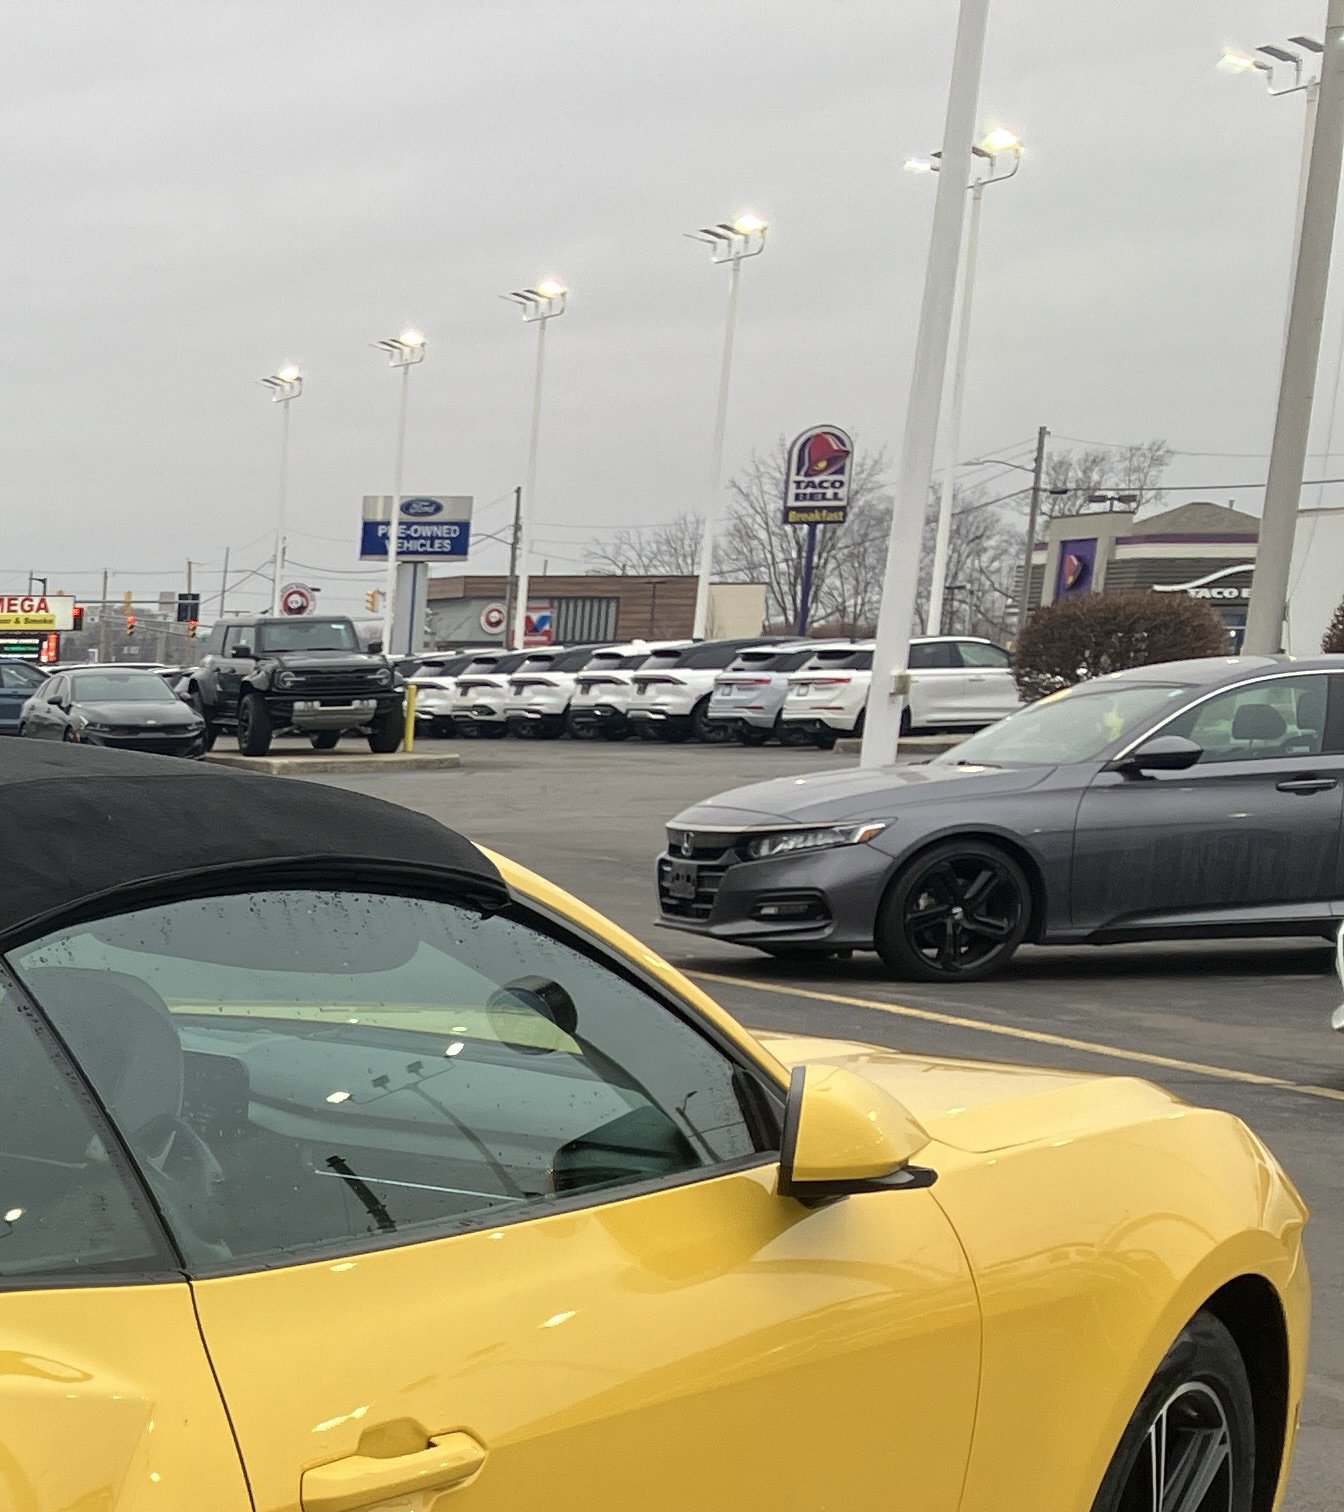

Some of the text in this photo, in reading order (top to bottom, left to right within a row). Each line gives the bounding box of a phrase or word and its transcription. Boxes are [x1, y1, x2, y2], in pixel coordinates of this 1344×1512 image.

[793, 480, 845, 489] TACO
[794, 492, 844, 501] BELL
[788, 510, 844, 522] Breakfast
[377, 525, 460, 537] PE-OWNED
[1187, 588, 1239, 599] TACO
